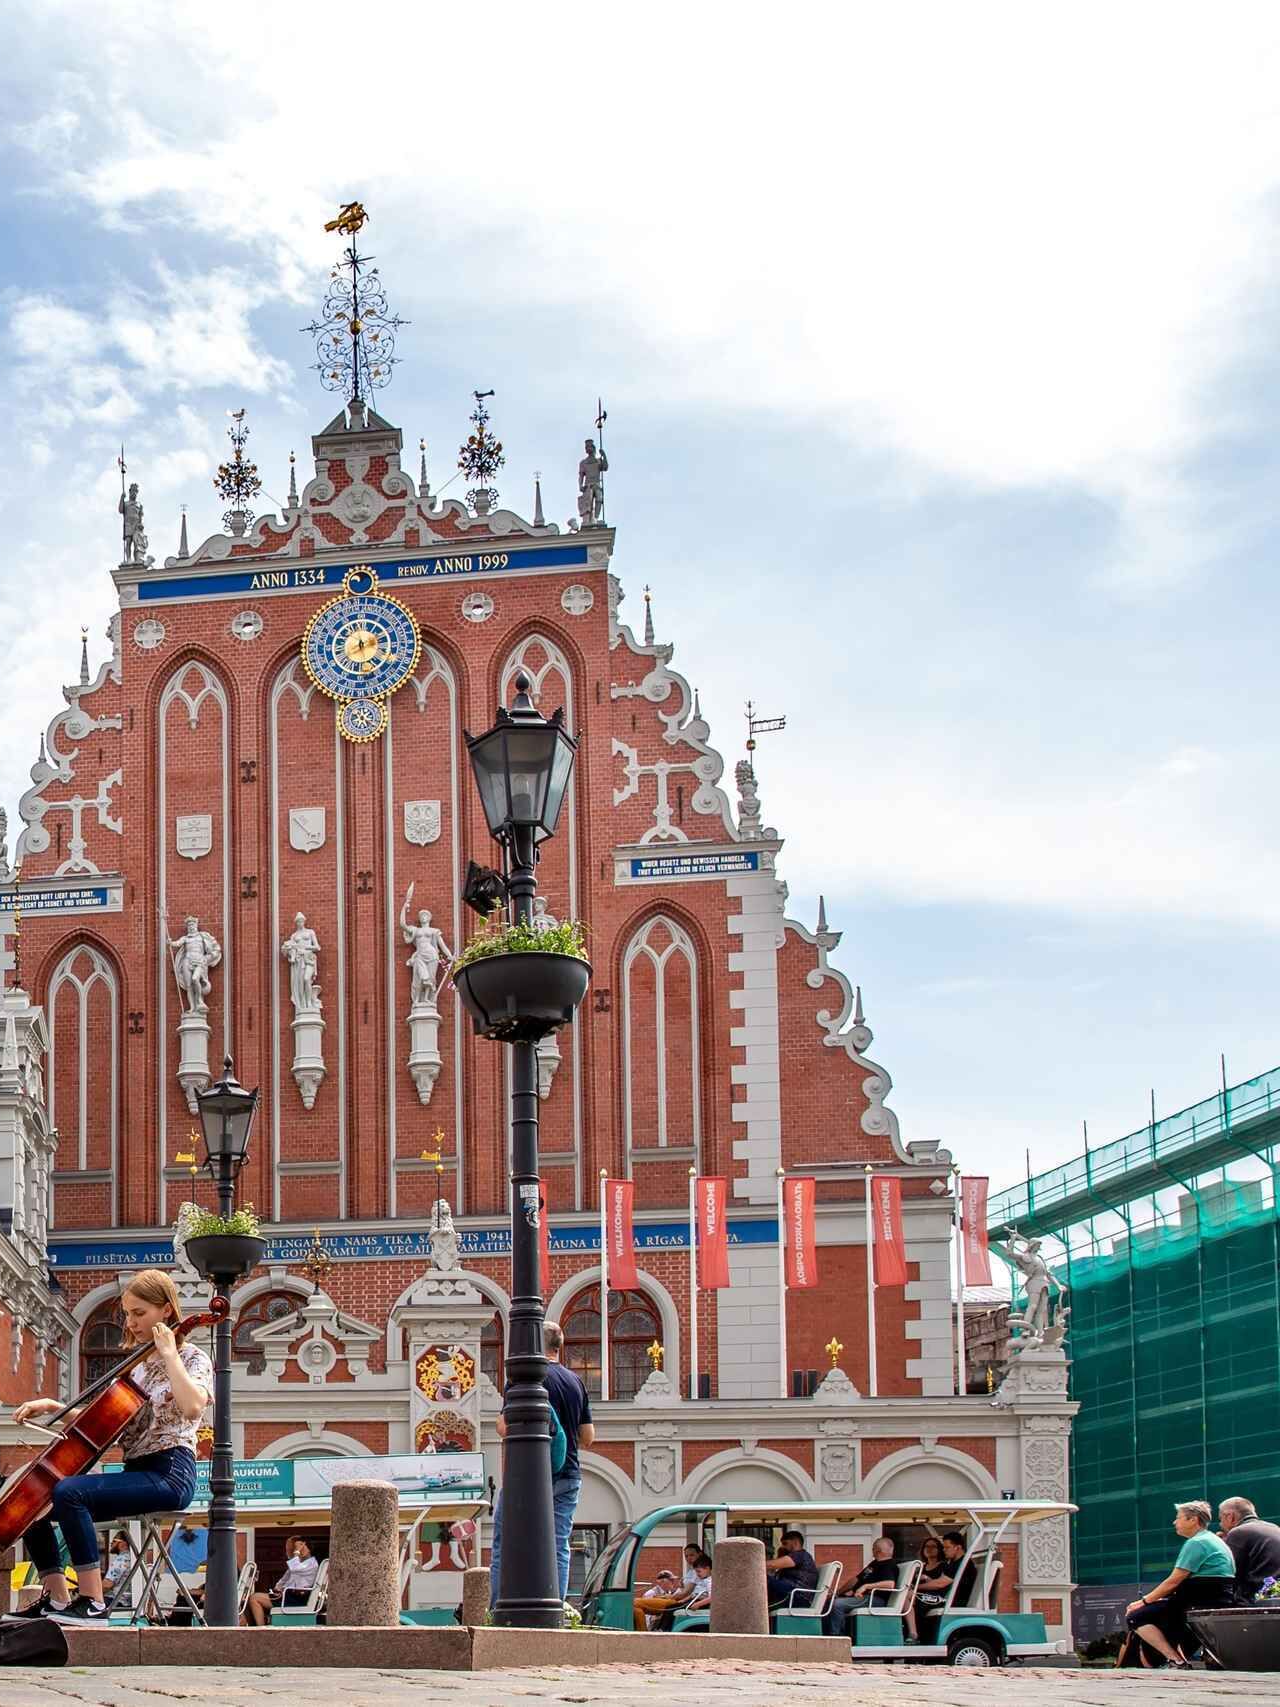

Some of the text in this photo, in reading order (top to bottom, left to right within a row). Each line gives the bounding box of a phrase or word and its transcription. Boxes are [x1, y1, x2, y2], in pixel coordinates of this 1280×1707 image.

[397, 554, 509, 577] RENOV. ANNO 1999
[250, 569, 325, 590] ANNO 1334
[706, 1182, 716, 1236] WELCOME
[881, 1181, 892, 1240] BIENVENUE
[615, 1185, 624, 1257] WILLKOMMEN
[344, 1236, 377, 1246] NAMS
[384, 1235, 412, 1245] TIKA
[366, 1246, 383, 1255] UZ
[233, 1467, 280, 1477] AUKUMĀ
